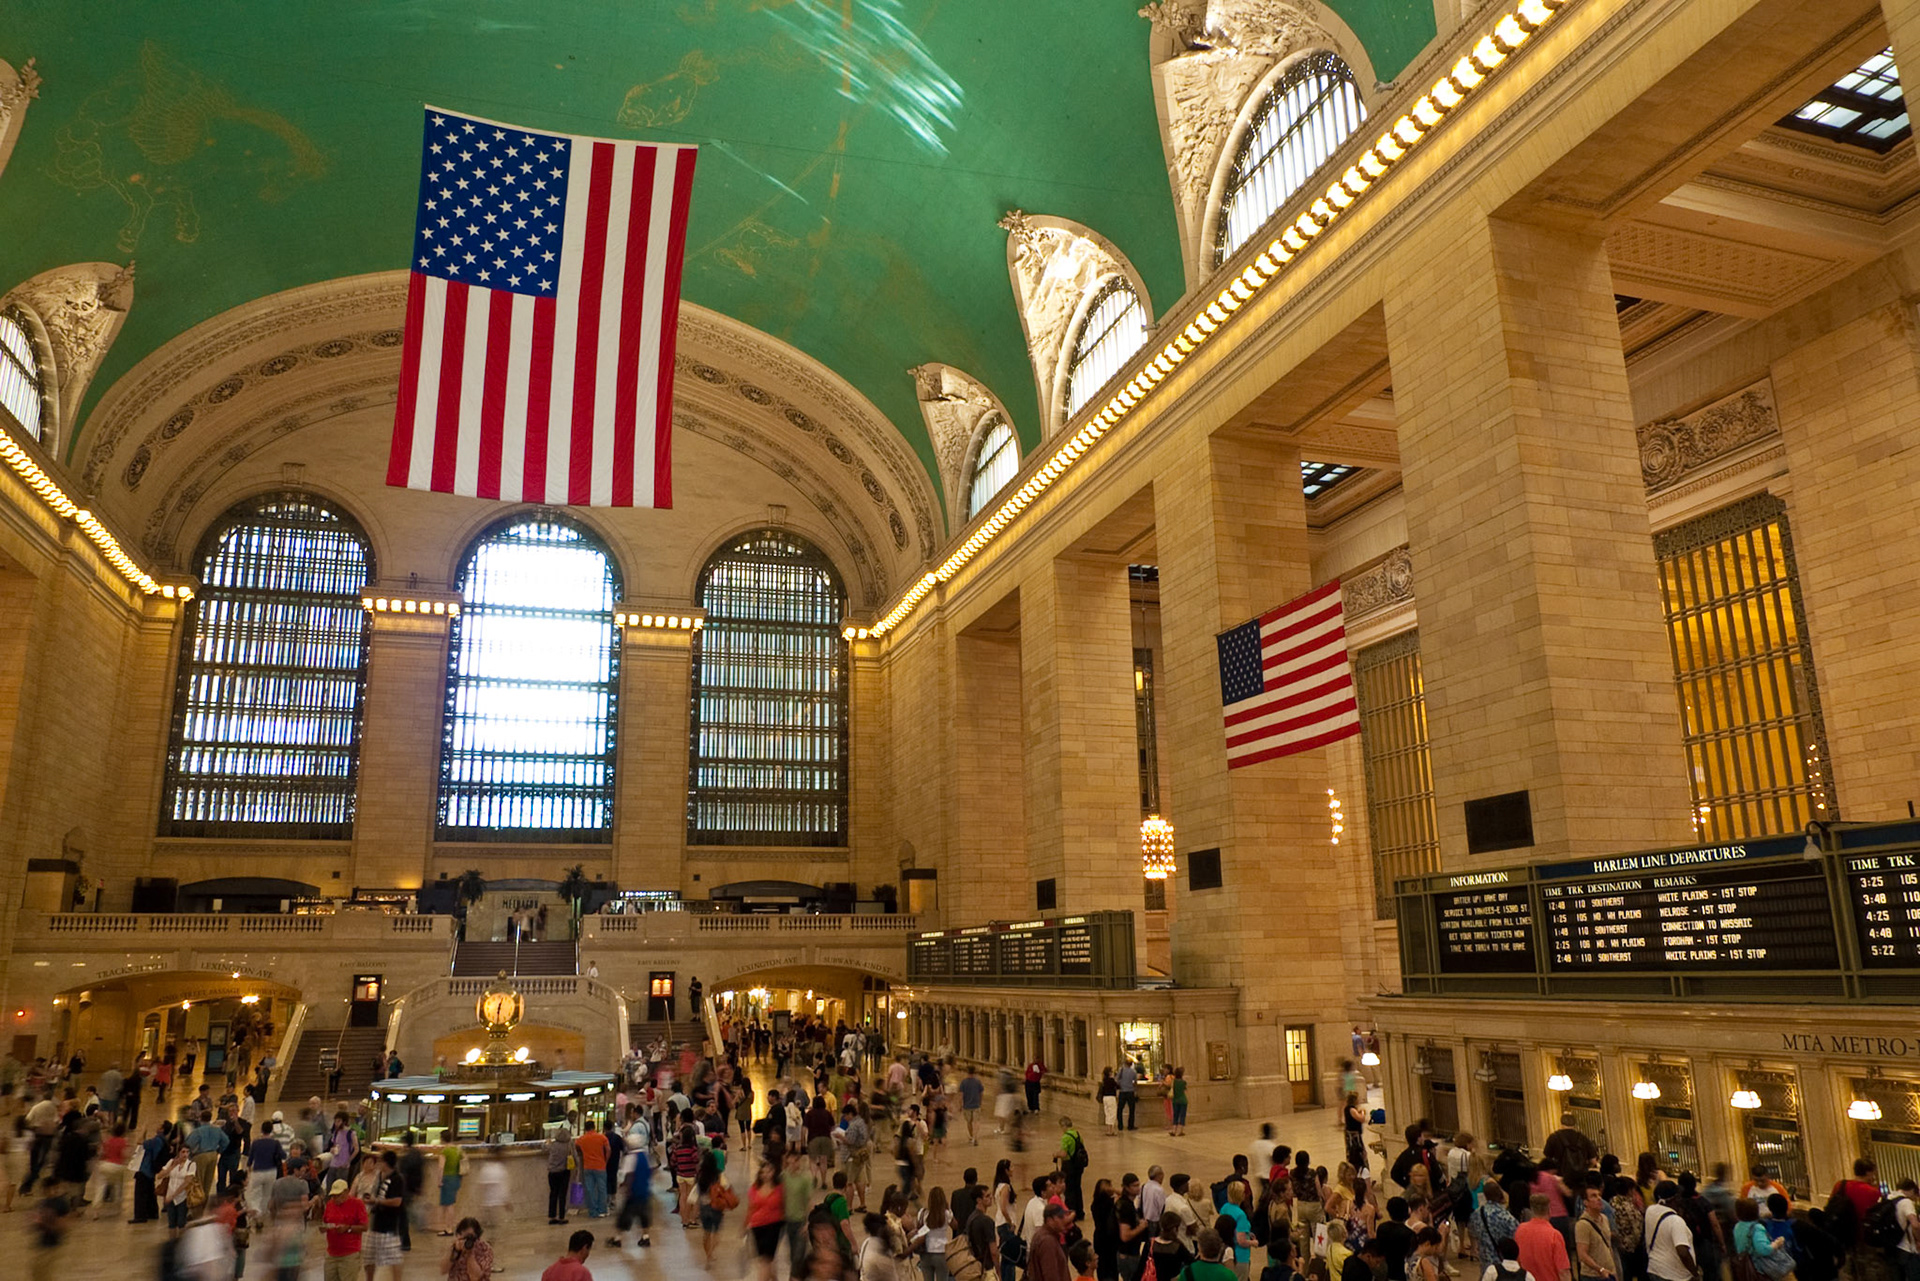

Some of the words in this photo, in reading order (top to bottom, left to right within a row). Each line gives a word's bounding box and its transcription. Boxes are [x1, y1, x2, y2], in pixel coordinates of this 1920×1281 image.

[1594, 858, 1638, 873] HARLEM
[1641, 854, 1667, 868] LINE
[1670, 845, 1746, 865] DEPARTURES
[1850, 857, 1879, 870] TIME
[1887, 855, 1915, 867] TRK
[1450, 872, 1508, 887] INFORMATION
[1544, 888, 1562, 896] TIME
[1567, 886, 1584, 895] TRK
[1588, 880, 1642, 893] DESTINATION
[1654, 875, 1697, 888] REMARKS
[1860, 876, 1884, 888] 3:25
[1900, 873, 1918, 885] 105
[1549, 901, 1565, 910] 12:48
[1575, 900, 1586, 908] 110
[1591, 897, 1624, 907] SOUTHEAST
[1658, 892, 1679, 902] WHITE
[1682, 890, 1708, 901] PLAINS
[1721, 888, 1734, 898] 1ST
[1738, 886, 1757, 897] STOP
[1863, 893, 1886, 905] 3:48
[1444, 908, 1464, 917] SERVICE
[1466, 908, 1472, 916] TO
[1554, 915, 1567, 923] 1:25
[1577, 913, 1587, 922] 105
[1593, 912, 1604, 921] NO.
[1618, 910, 1642, 919] PLAINS
[1660, 907, 1689, 917] MELROSE
[1702, 905, 1714, 915] 1ST
[1718, 903, 1736, 914] STOP
[1866, 910, 1890, 921] 4:25
[1504, 918, 1513, 926] ALL
[1555, 928, 1568, 936] 1:48
[1578, 927, 1589, 935] 110
[1595, 925, 1628, 934] SOUTHEAST
[1662, 921, 1704, 932] CONNECTION
[1707, 920, 1716, 929] TO
[1720, 918, 1752, 928] WASSAIC
[1491, 930, 1512, 939] TICKETS
[1869, 928, 1892, 938] 4:48
[1556, 941, 1570, 949] 2:25
[1596, 939, 1607, 948] NO.
[1622, 938, 1645, 947] PLAINS
[1664, 936, 1693, 946] FORDHAM
[1706, 935, 1718, 944] 1ST
[1722, 934, 1741, 944] STOP
[1557, 954, 1572, 963] 2:48
[1581, 953, 1592, 962] 110
[1598, 952, 1631, 962] SOUTHEAST
[1665, 951, 1686, 960] WHITE
[1690, 950, 1716, 960] PLAINS
[1730, 949, 1743, 959] 1ST
[1747, 949, 1766, 959] STOP
[1871, 945, 1895, 956] 5:22
[96, 966, 133, 978] TRACKS
[201, 962, 254, 975] LEXINGTON
[256, 969, 272, 979] AVE
[736, 959, 782, 974] LEXINGTON
[783, 956, 798, 964] AVE
[1782, 1034, 1824, 1051] MTA
